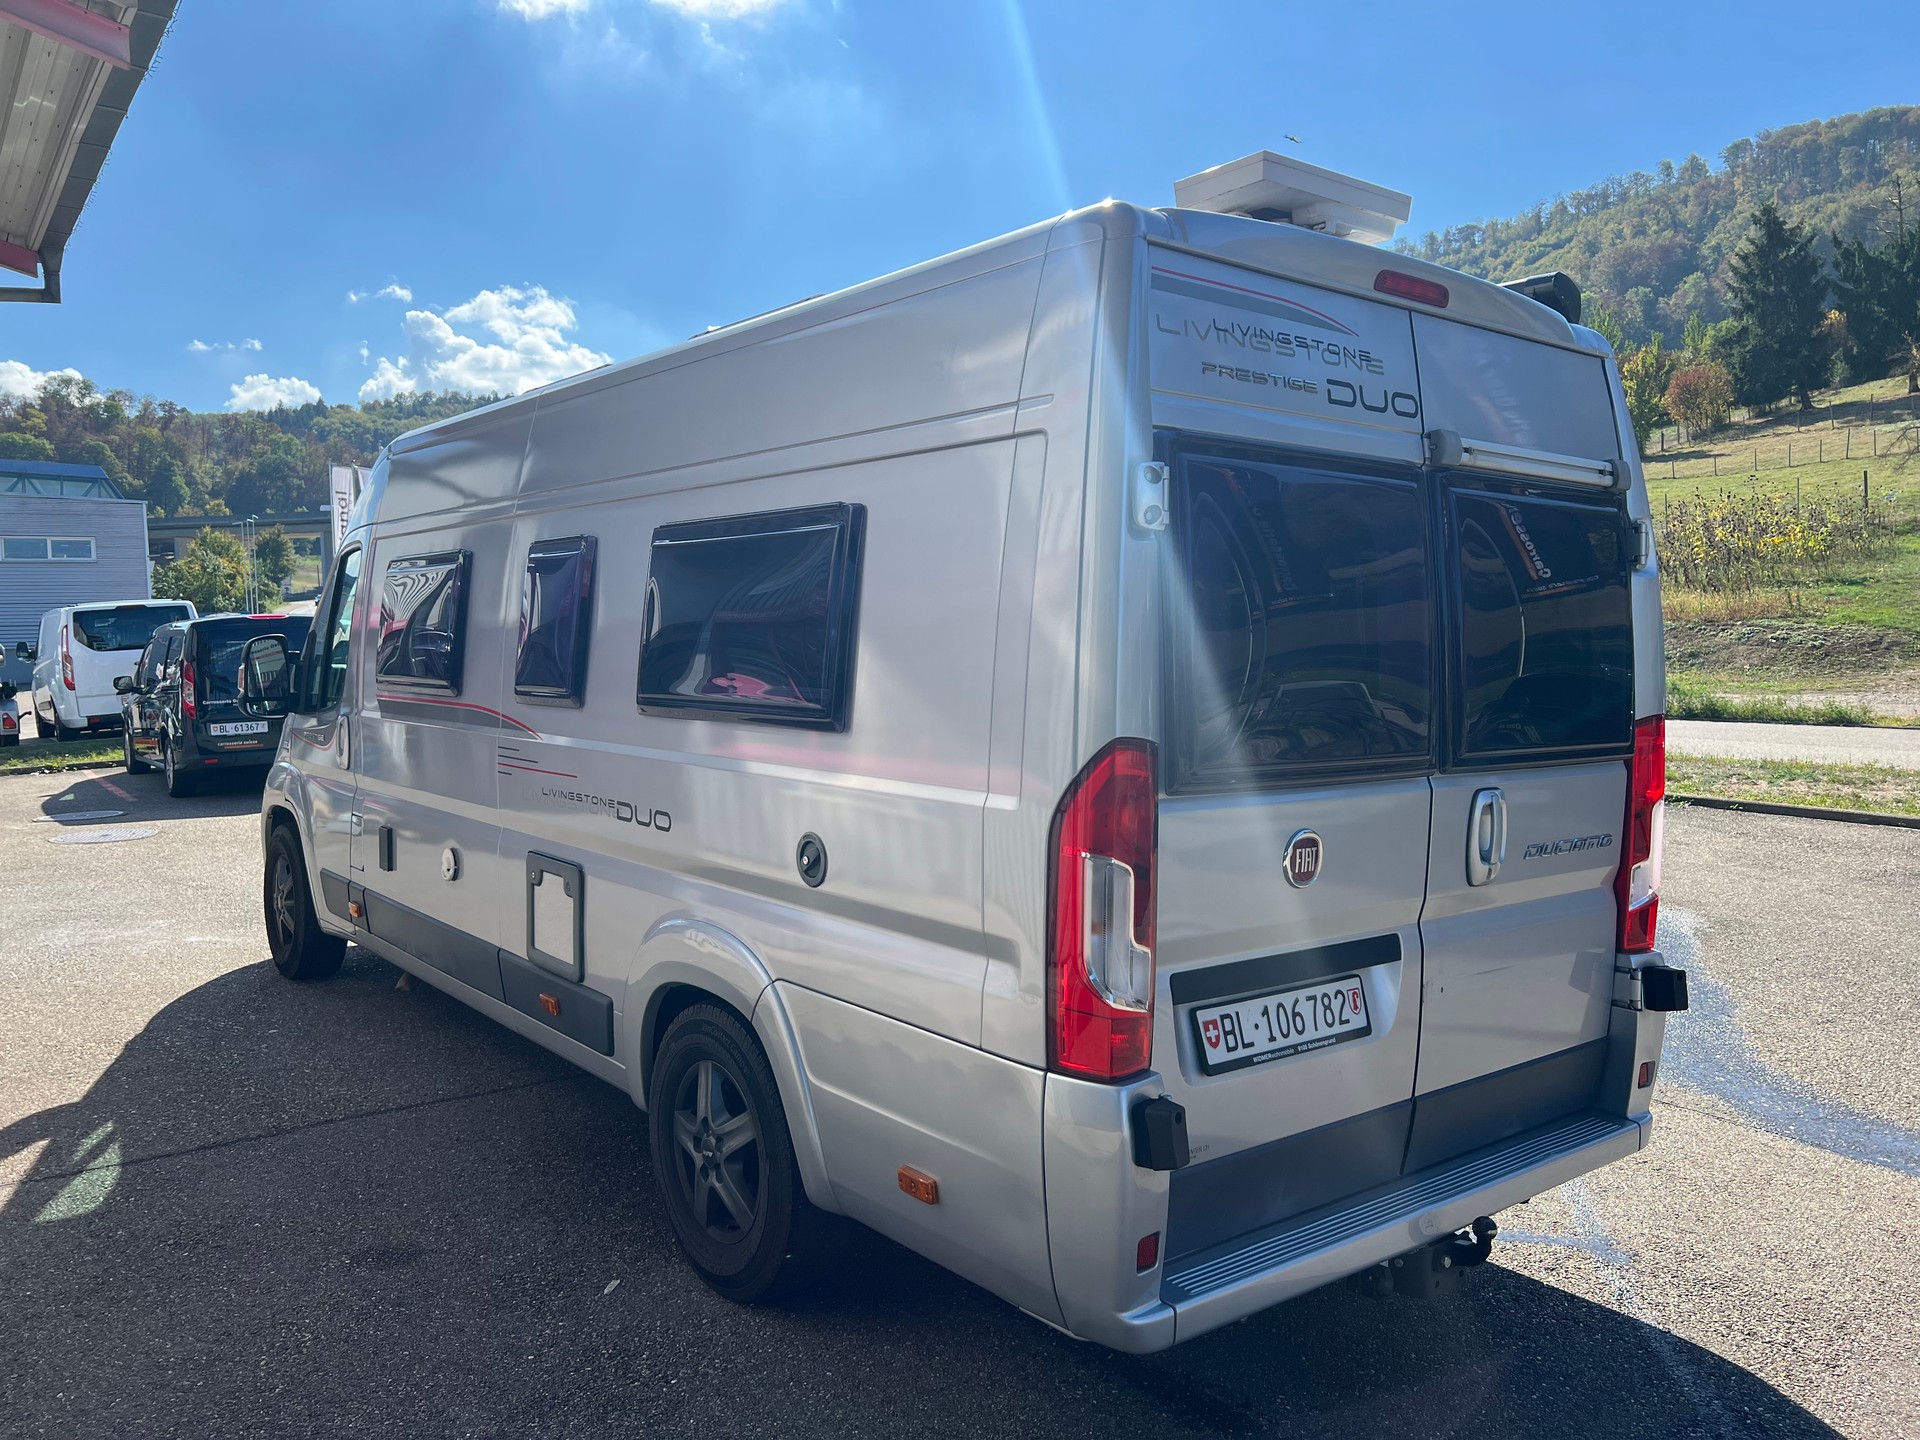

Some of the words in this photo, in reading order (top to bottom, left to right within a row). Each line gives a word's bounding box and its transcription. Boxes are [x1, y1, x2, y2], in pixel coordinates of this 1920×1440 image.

[1212, 317, 1372, 364] LIVINGSTONE
[1201, 361, 1319, 394] PRESTIGE
[1326, 378, 1420, 419] DUO
[541, 786, 616, 809] LIVINGSTONE
[616, 800, 672, 833] DUO
[1294, 846, 1318, 874] FIAT
[1524, 833, 1614, 861] DUCATO
